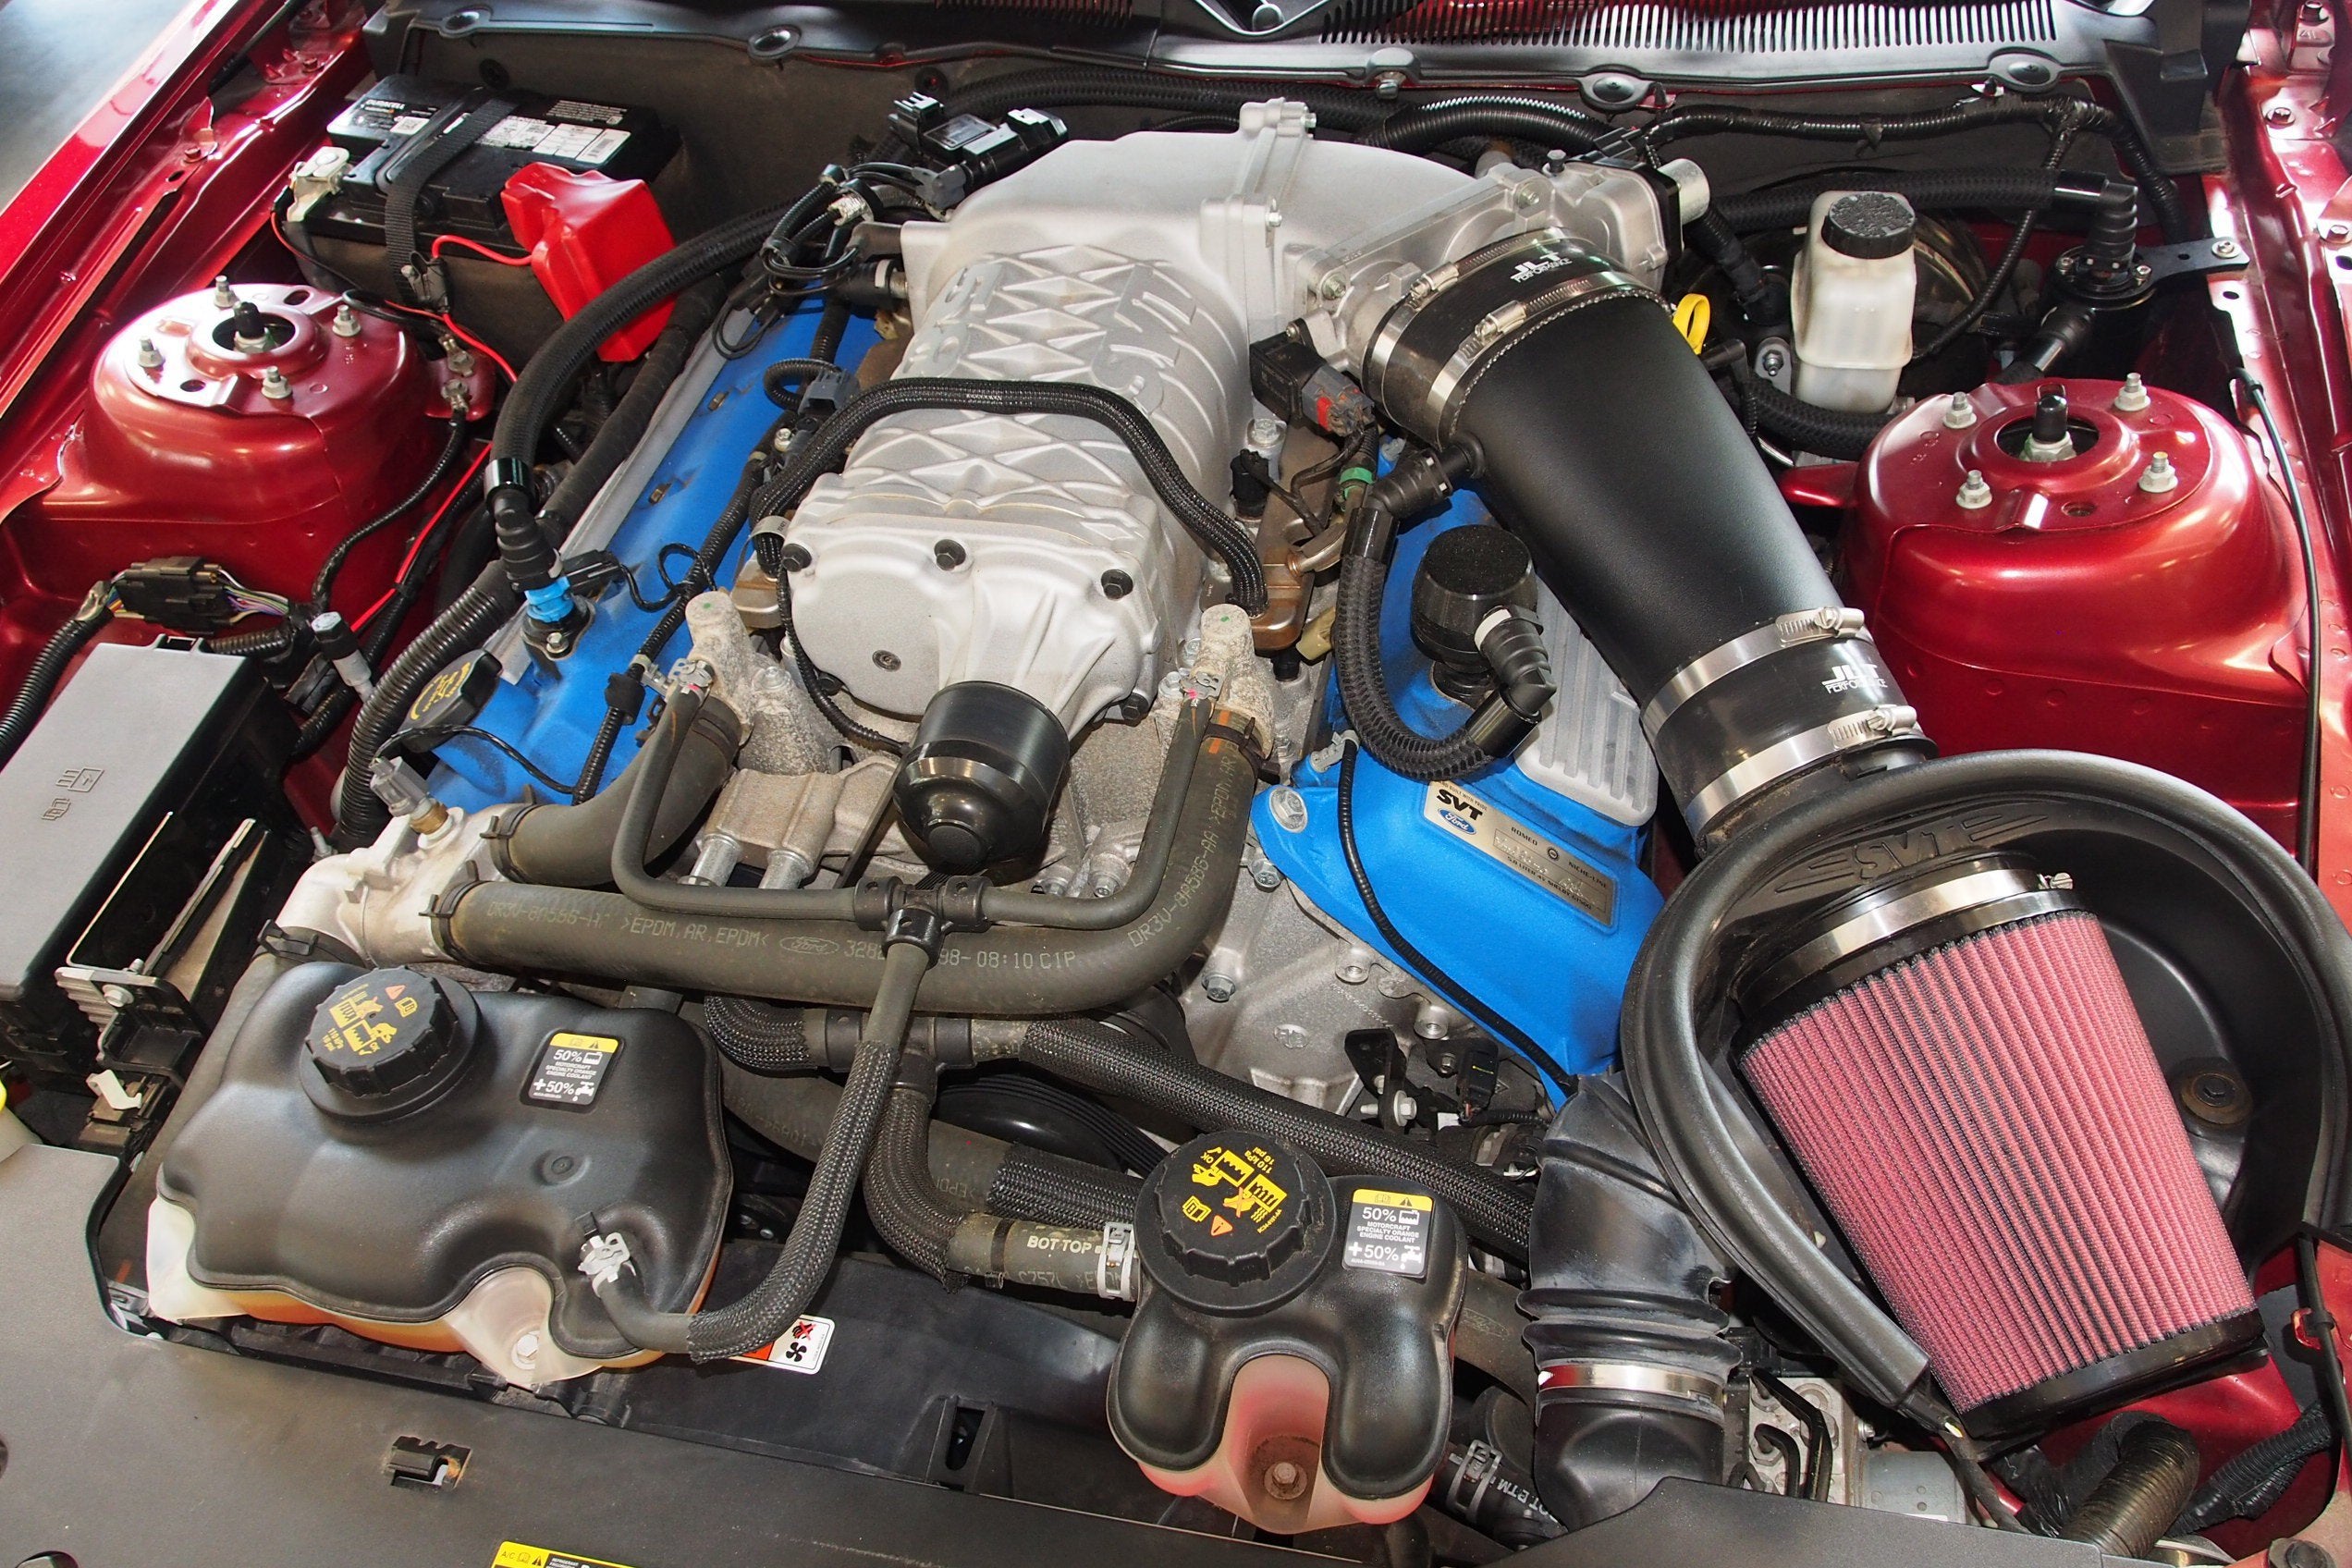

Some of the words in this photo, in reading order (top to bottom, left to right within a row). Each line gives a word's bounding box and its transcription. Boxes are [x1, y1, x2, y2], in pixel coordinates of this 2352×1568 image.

[1511, 252, 1561, 279] JLT
[1821, 664, 1880, 685] JLT
[1437, 789, 1484, 821] SVT
[1442, 810, 1472, 833] Ford
[1510, 827, 1538, 847] ROMEO
[553, 1049, 582, 1062] 50%
[1200, 1152, 1214, 1164] OK
[1362, 1207, 1397, 1222] 50%
[1356, 1225, 1391, 1235] SPECIALTY
[1391, 1230, 1420, 1239] ORANGE
[1366, 1221, 1411, 1231] MOTORCRAFT
[1359, 1231, 1384, 1240] ENGINE
[1384, 1234, 1415, 1243] COOLANT
[1062, 1240, 1092, 1255] TOP
